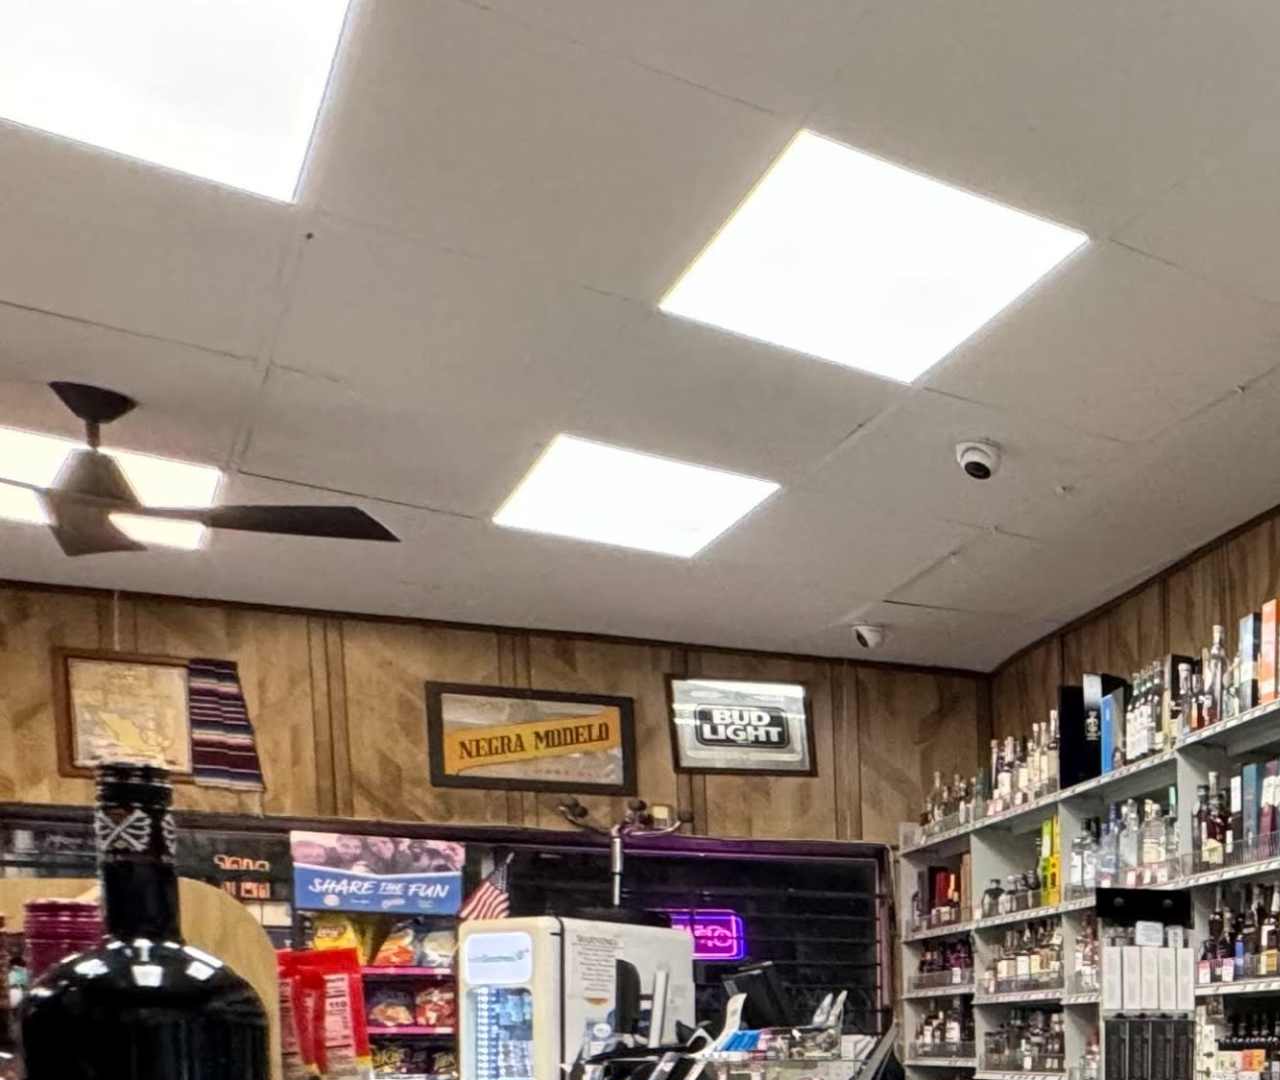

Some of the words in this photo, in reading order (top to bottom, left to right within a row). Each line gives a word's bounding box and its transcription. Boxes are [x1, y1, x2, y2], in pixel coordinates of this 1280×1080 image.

[713, 709, 771, 725] BUD
[458, 733, 525, 760] NEGRA
[534, 722, 610, 749] MODELO
[703, 723, 783, 742] LIGHT
[308, 877, 378, 895] SHARE
[379, 883, 404, 896] THE
[407, 883, 450, 899] FUN
